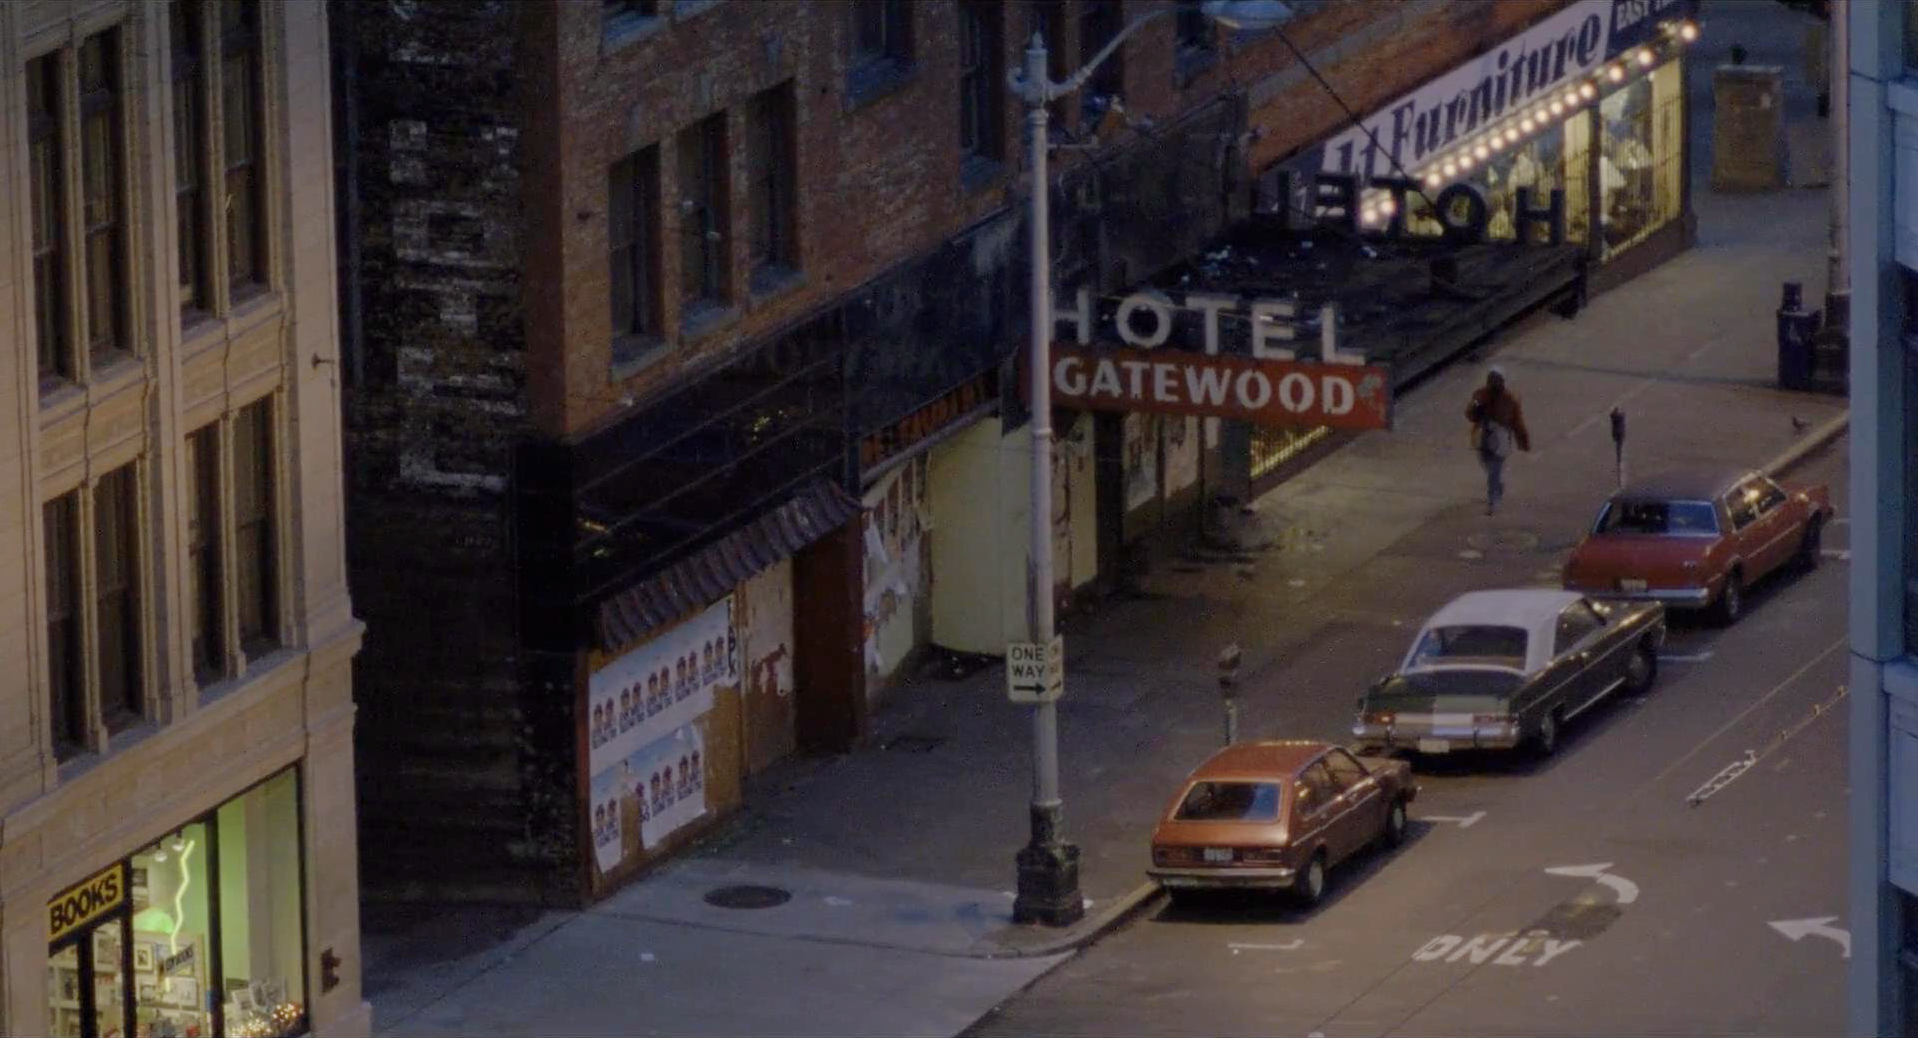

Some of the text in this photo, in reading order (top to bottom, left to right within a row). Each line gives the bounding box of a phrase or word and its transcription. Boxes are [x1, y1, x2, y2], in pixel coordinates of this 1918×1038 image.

[1390, 12, 1600, 172] Furniture
[1050, 286, 1366, 366] HOTEL
[1053, 356, 1356, 416] GATEWOOD
[1011, 664, 1045, 679] WAY
[1012, 646, 1044, 662] ONE
[50, 873, 119, 934] BOOKS
[1410, 929, 1584, 967] ONLY
